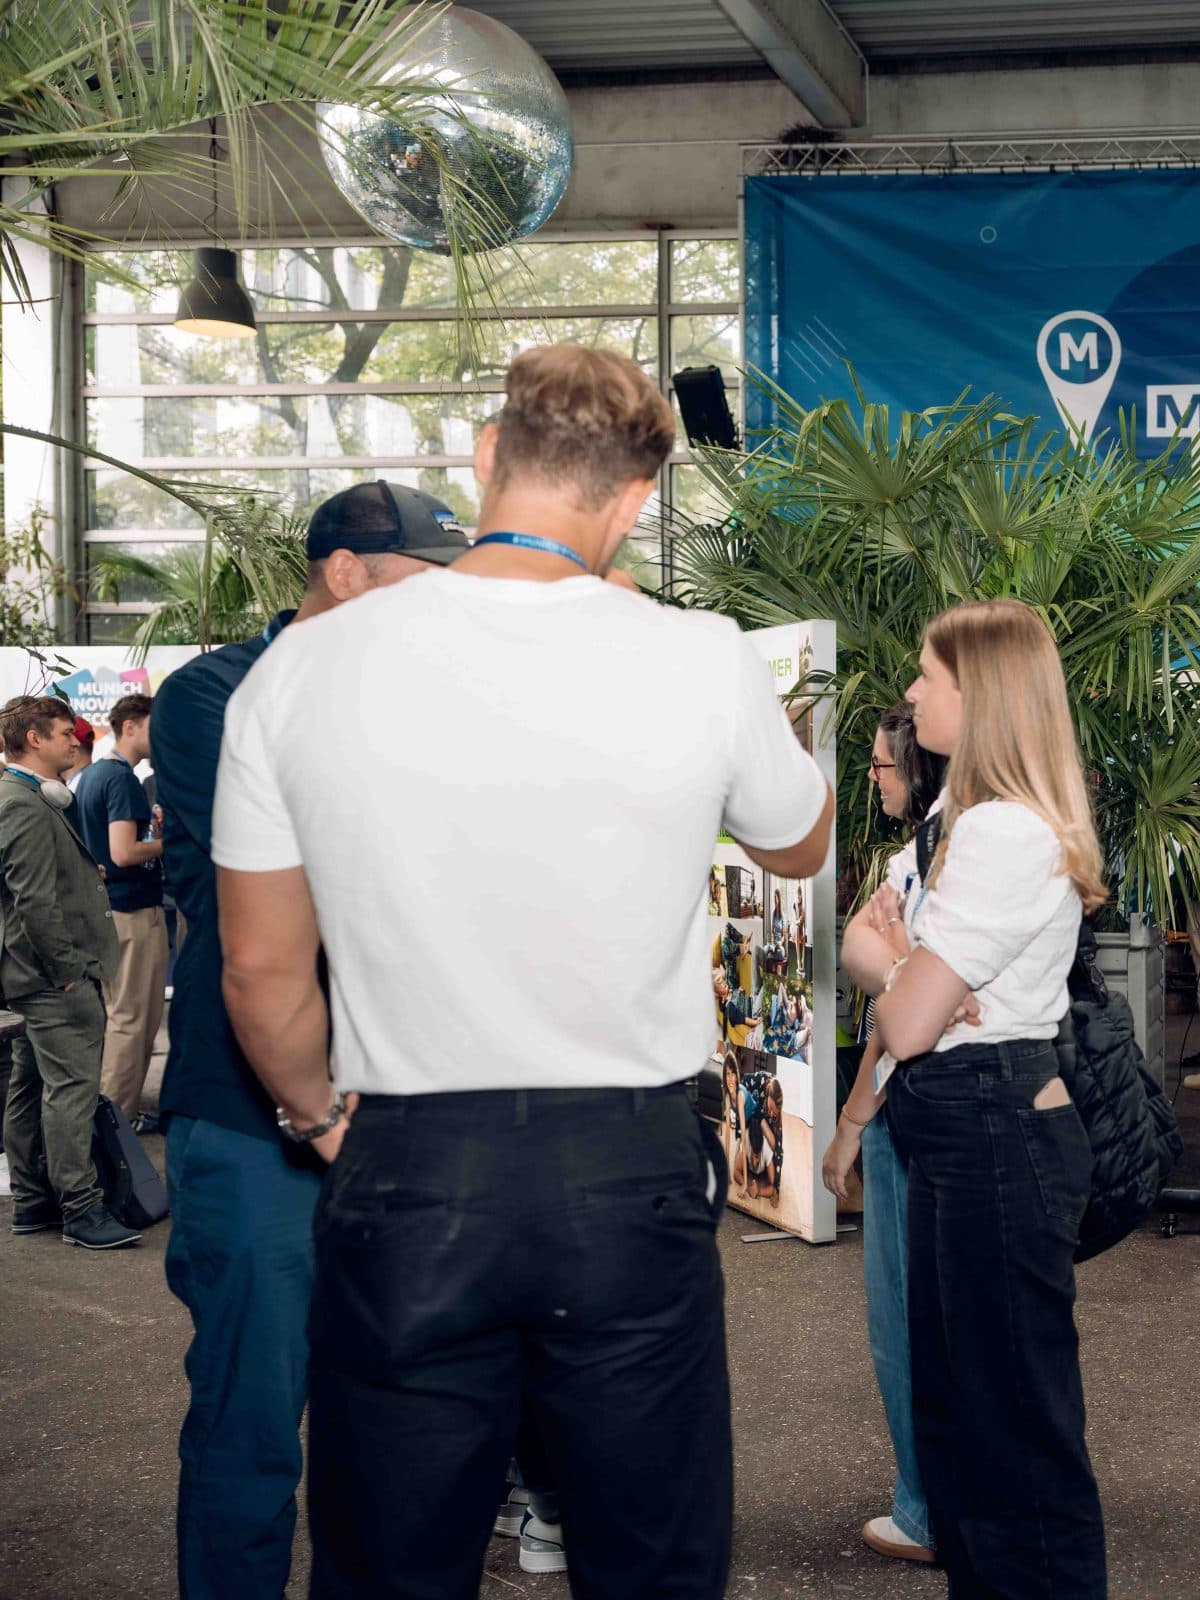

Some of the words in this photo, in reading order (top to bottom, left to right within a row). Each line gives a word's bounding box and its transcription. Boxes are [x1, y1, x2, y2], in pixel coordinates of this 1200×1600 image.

[1059, 332, 1099, 370] M
[768, 657, 792, 678] MER
[78, 681, 142, 695] MUNICH
